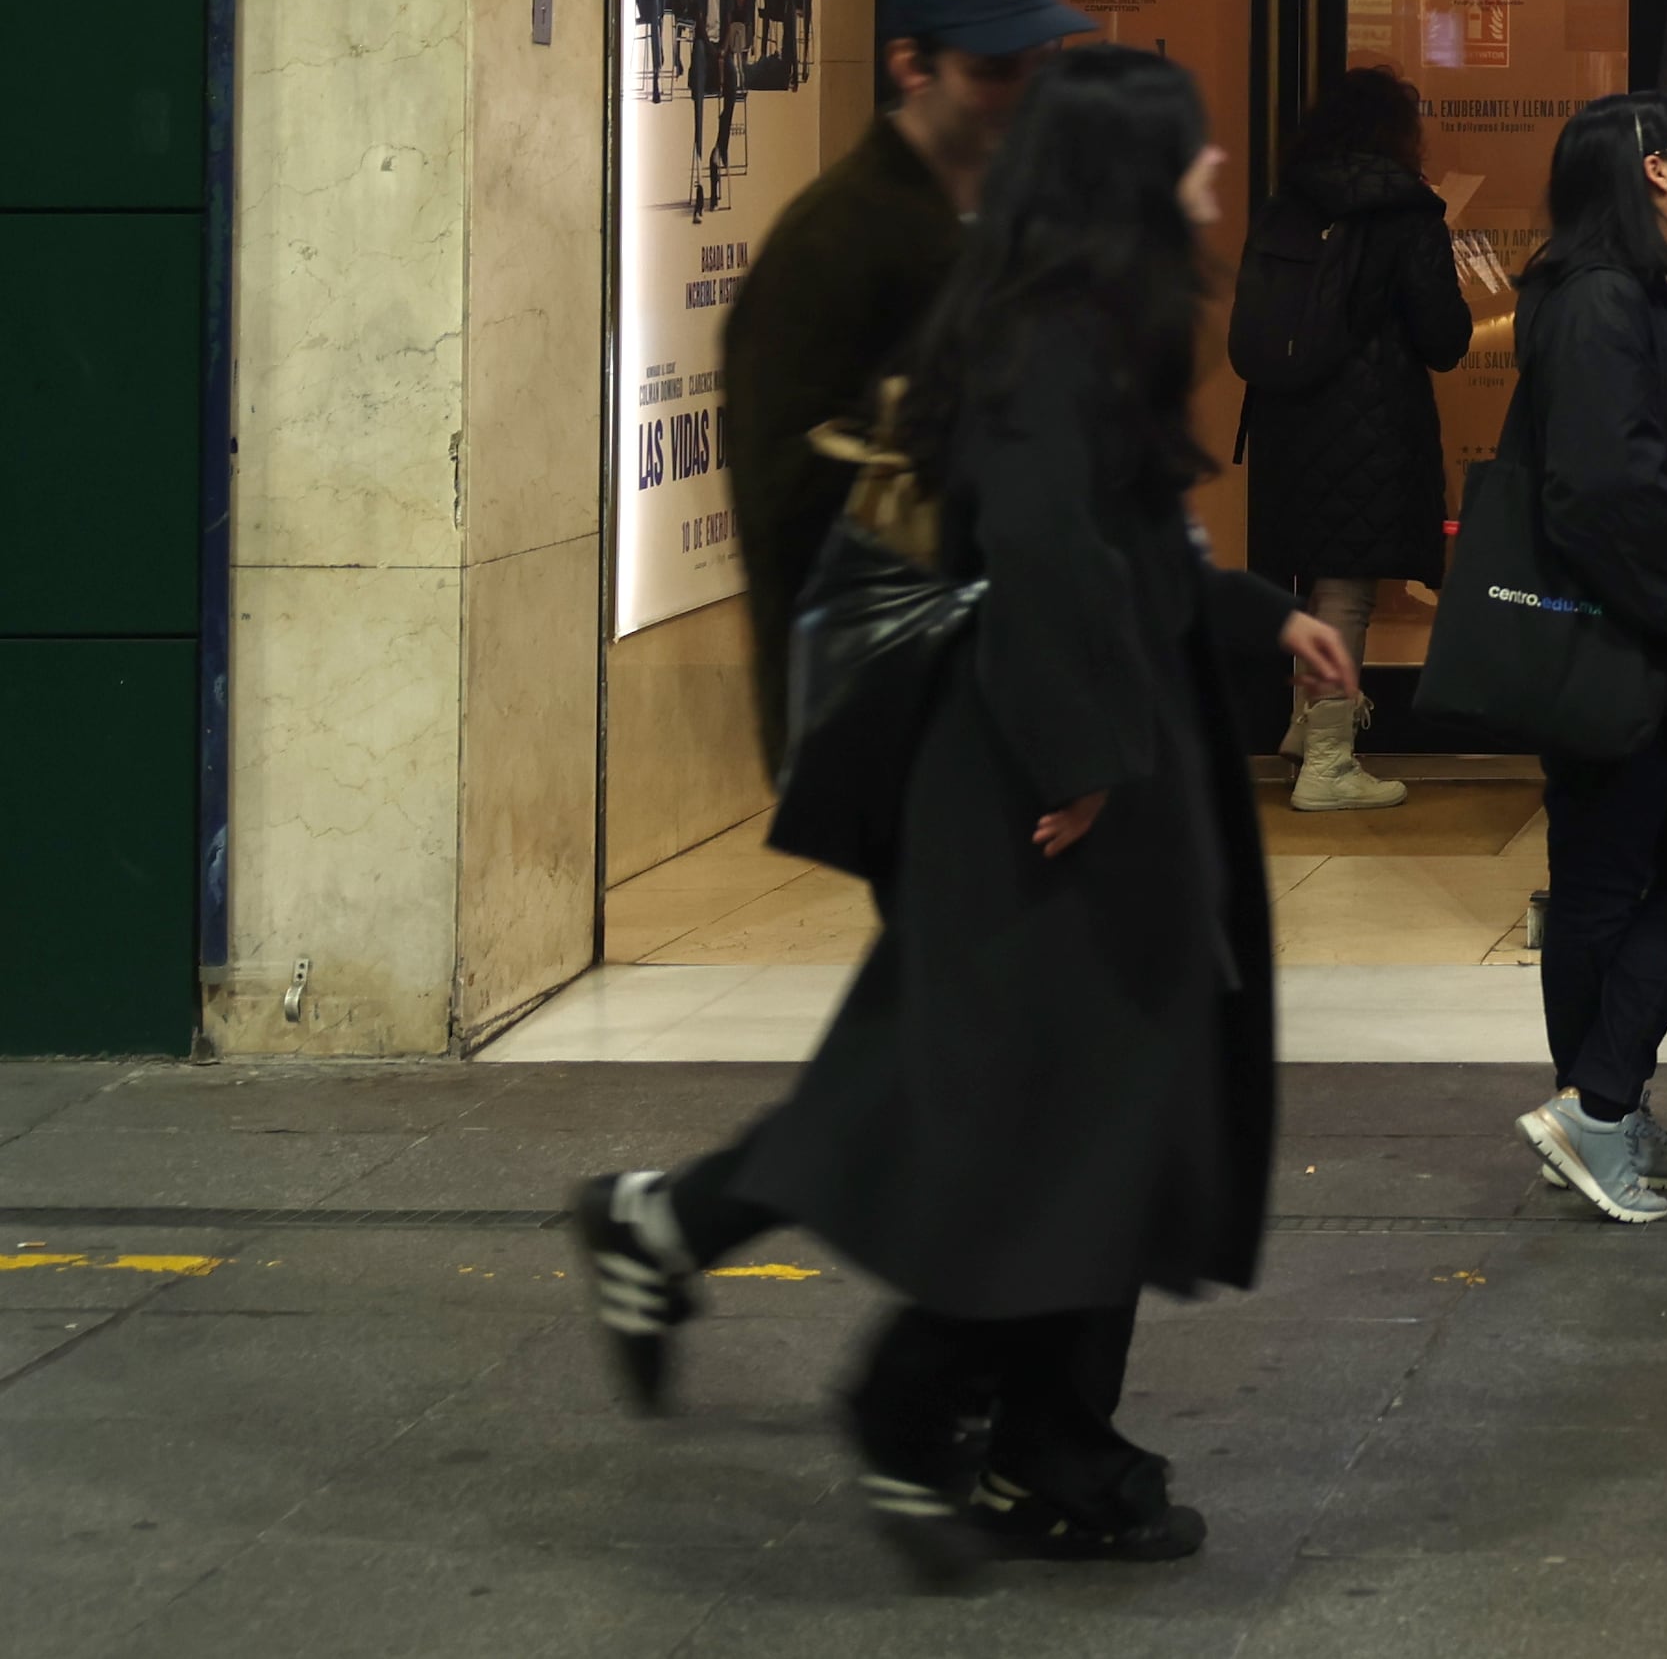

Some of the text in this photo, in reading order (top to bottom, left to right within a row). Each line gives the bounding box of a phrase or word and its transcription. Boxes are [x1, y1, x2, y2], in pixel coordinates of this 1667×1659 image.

[1440, 99, 1510, 118] EXUBERANTE
[1513, 100, 1520, 118] Y
[1522, 100, 1555, 118] LLENA
[1557, 100, 1571, 118] DE
[701, 241, 749, 273] BASADA EN UNA
[685, 276, 717, 310] INCREÍBLE
[638, 408, 710, 491] LAS VIDAS
[682, 509, 729, 554] 10 DE ENERO
